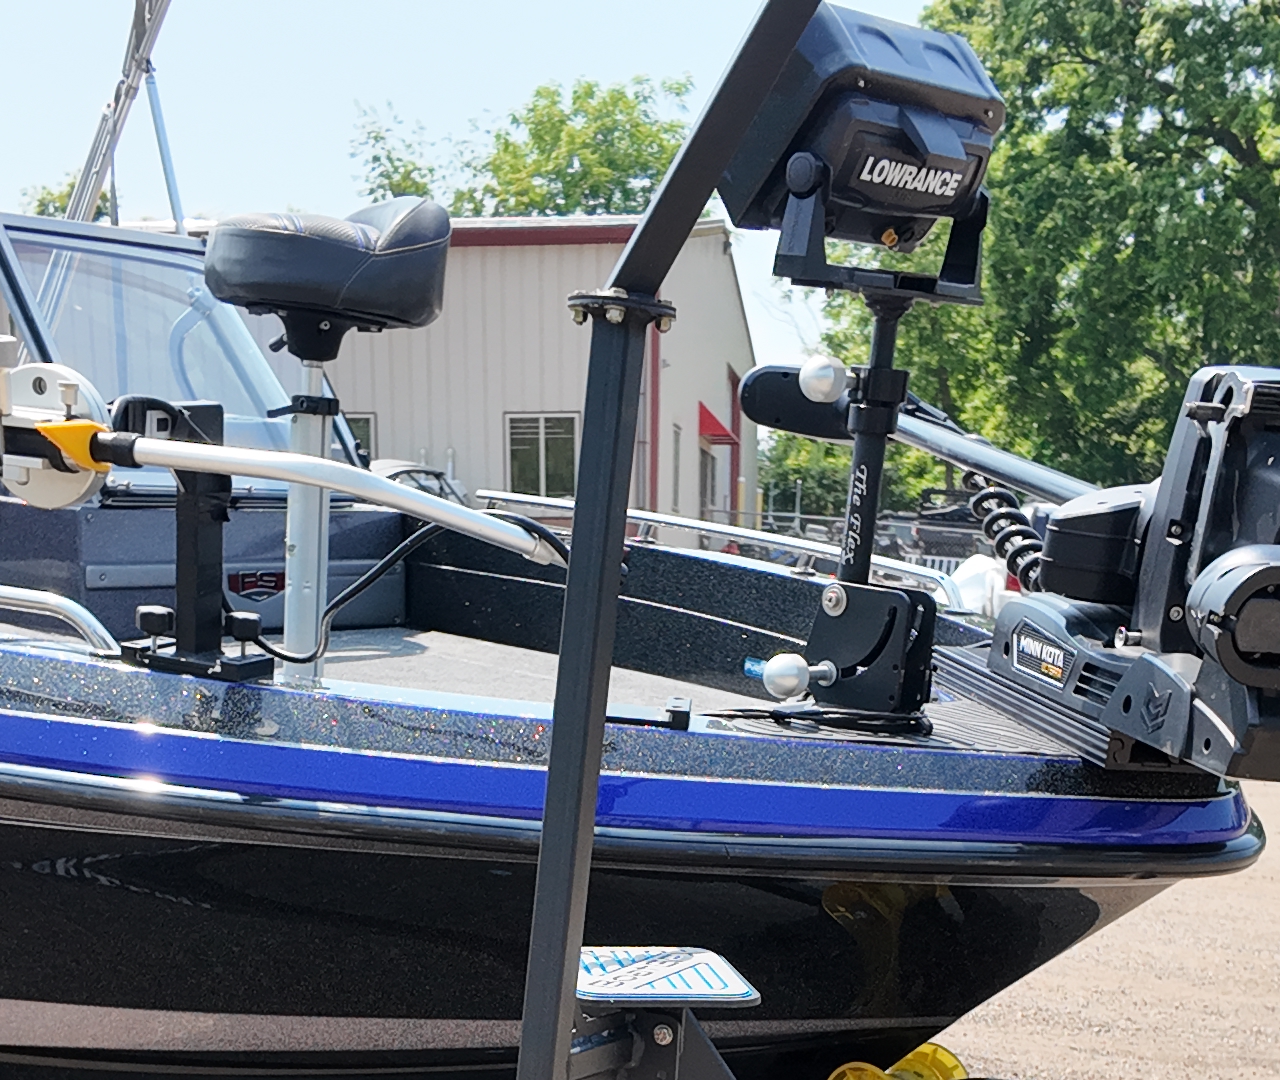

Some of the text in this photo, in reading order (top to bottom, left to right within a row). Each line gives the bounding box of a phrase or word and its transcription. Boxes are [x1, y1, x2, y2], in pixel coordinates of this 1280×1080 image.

[860, 156, 963, 196] LOWRANCE
[852, 464, 868, 507] The
[841, 513, 862, 565] Flex
[1019, 635, 1064, 668] MINN KOTA
